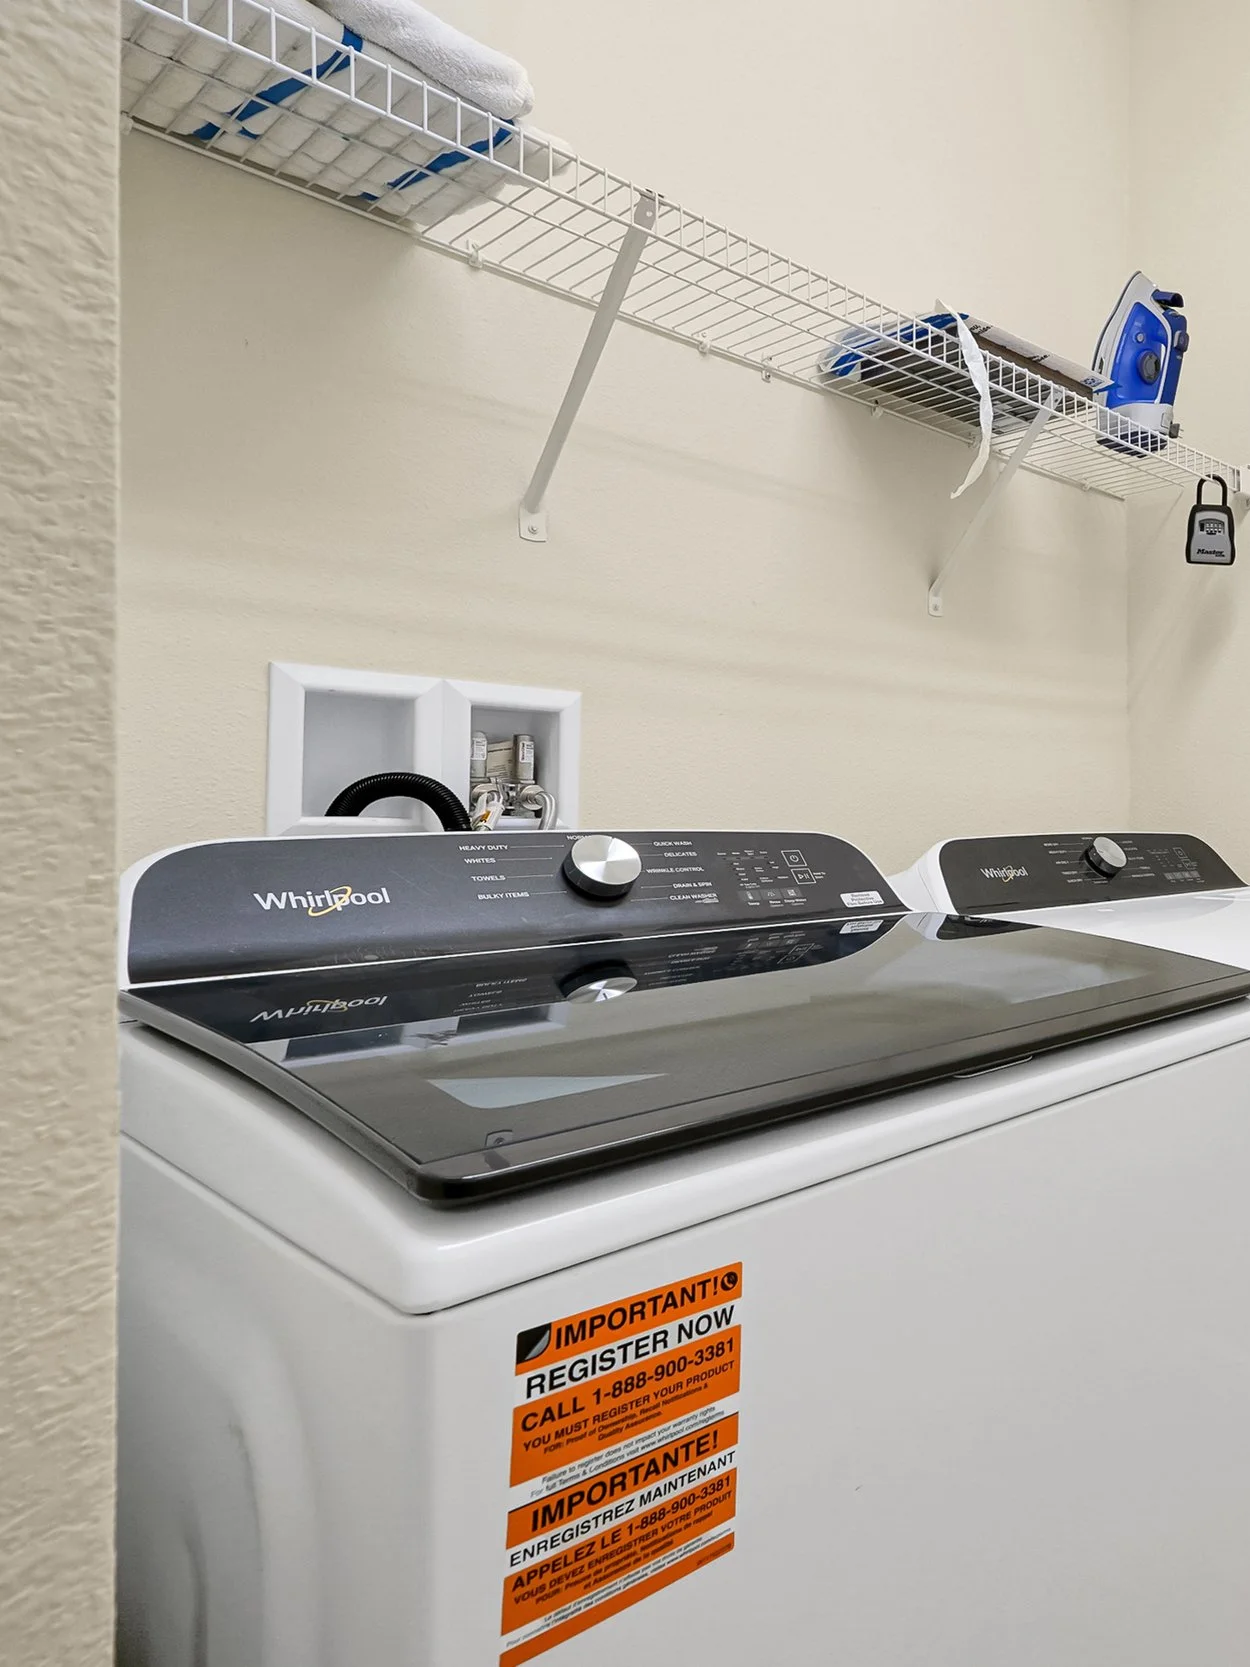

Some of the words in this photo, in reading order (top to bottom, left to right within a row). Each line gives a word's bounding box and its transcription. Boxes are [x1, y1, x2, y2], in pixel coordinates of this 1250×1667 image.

[253, 886, 391, 917] Whirlpool
[477, 893, 505, 901] BULKY
[505, 891, 530, 899] ITEMS
[979, 866, 1029, 882] Whirlpool
[555, 1275, 717, 1350] IMPORTANT!
[520, 1392, 585, 1434] CALL
[592, 1336, 732, 1406] 1-888-900-3381
[526, 1328, 668, 1399] REGISTER
[677, 1304, 733, 1344] NOW
[523, 1432, 550, 1452] YOU
[554, 1417, 588, 1440] MUST
[592, 1393, 649, 1425] REGISTER
[653, 1380, 682, 1400] YOUR
[686, 1360, 733, 1387] PRODUCT
[566, 1431, 586, 1445] Proof
[588, 1428, 596, 1436] of
[640, 1401, 660, 1415] Recall
[662, 1384, 702, 1405] Notifications
[598, 1425, 623, 1441] Quality
[531, 1429, 717, 1533] IMPORTANTE!
[542, 1467, 567, 1484] Failure
[568, 1463, 575, 1472] to
[577, 1452, 603, 1470] register
[605, 1445, 621, 1457] does
[622, 1439, 633, 1449] not
[635, 1430, 655, 1445] impact
[657, 1424, 670, 1435] your
[672, 1412, 698, 1429] warranty
[558, 1471, 580, 1486] Terms
[582, 1468, 587, 1476] &
[589, 1452, 624, 1473] Conditions
[626, 1446, 639, 1457] visit
[509, 1497, 634, 1568] ENREGISTREZ
[639, 1450, 735, 1507] MAINTENANT
[512, 1539, 596, 1593] APPELEZ
[600, 1527, 621, 1549] LE
[626, 1475, 729, 1537] 1-888-900-3381
[514, 1582, 546, 1606] VOUS
[549, 1563, 584, 1588] DEVEZ
[588, 1526, 658, 1570] ENREGISTRER
[661, 1510, 691, 1533] VOTRE
[694, 1489, 731, 1516] PRODUIT
